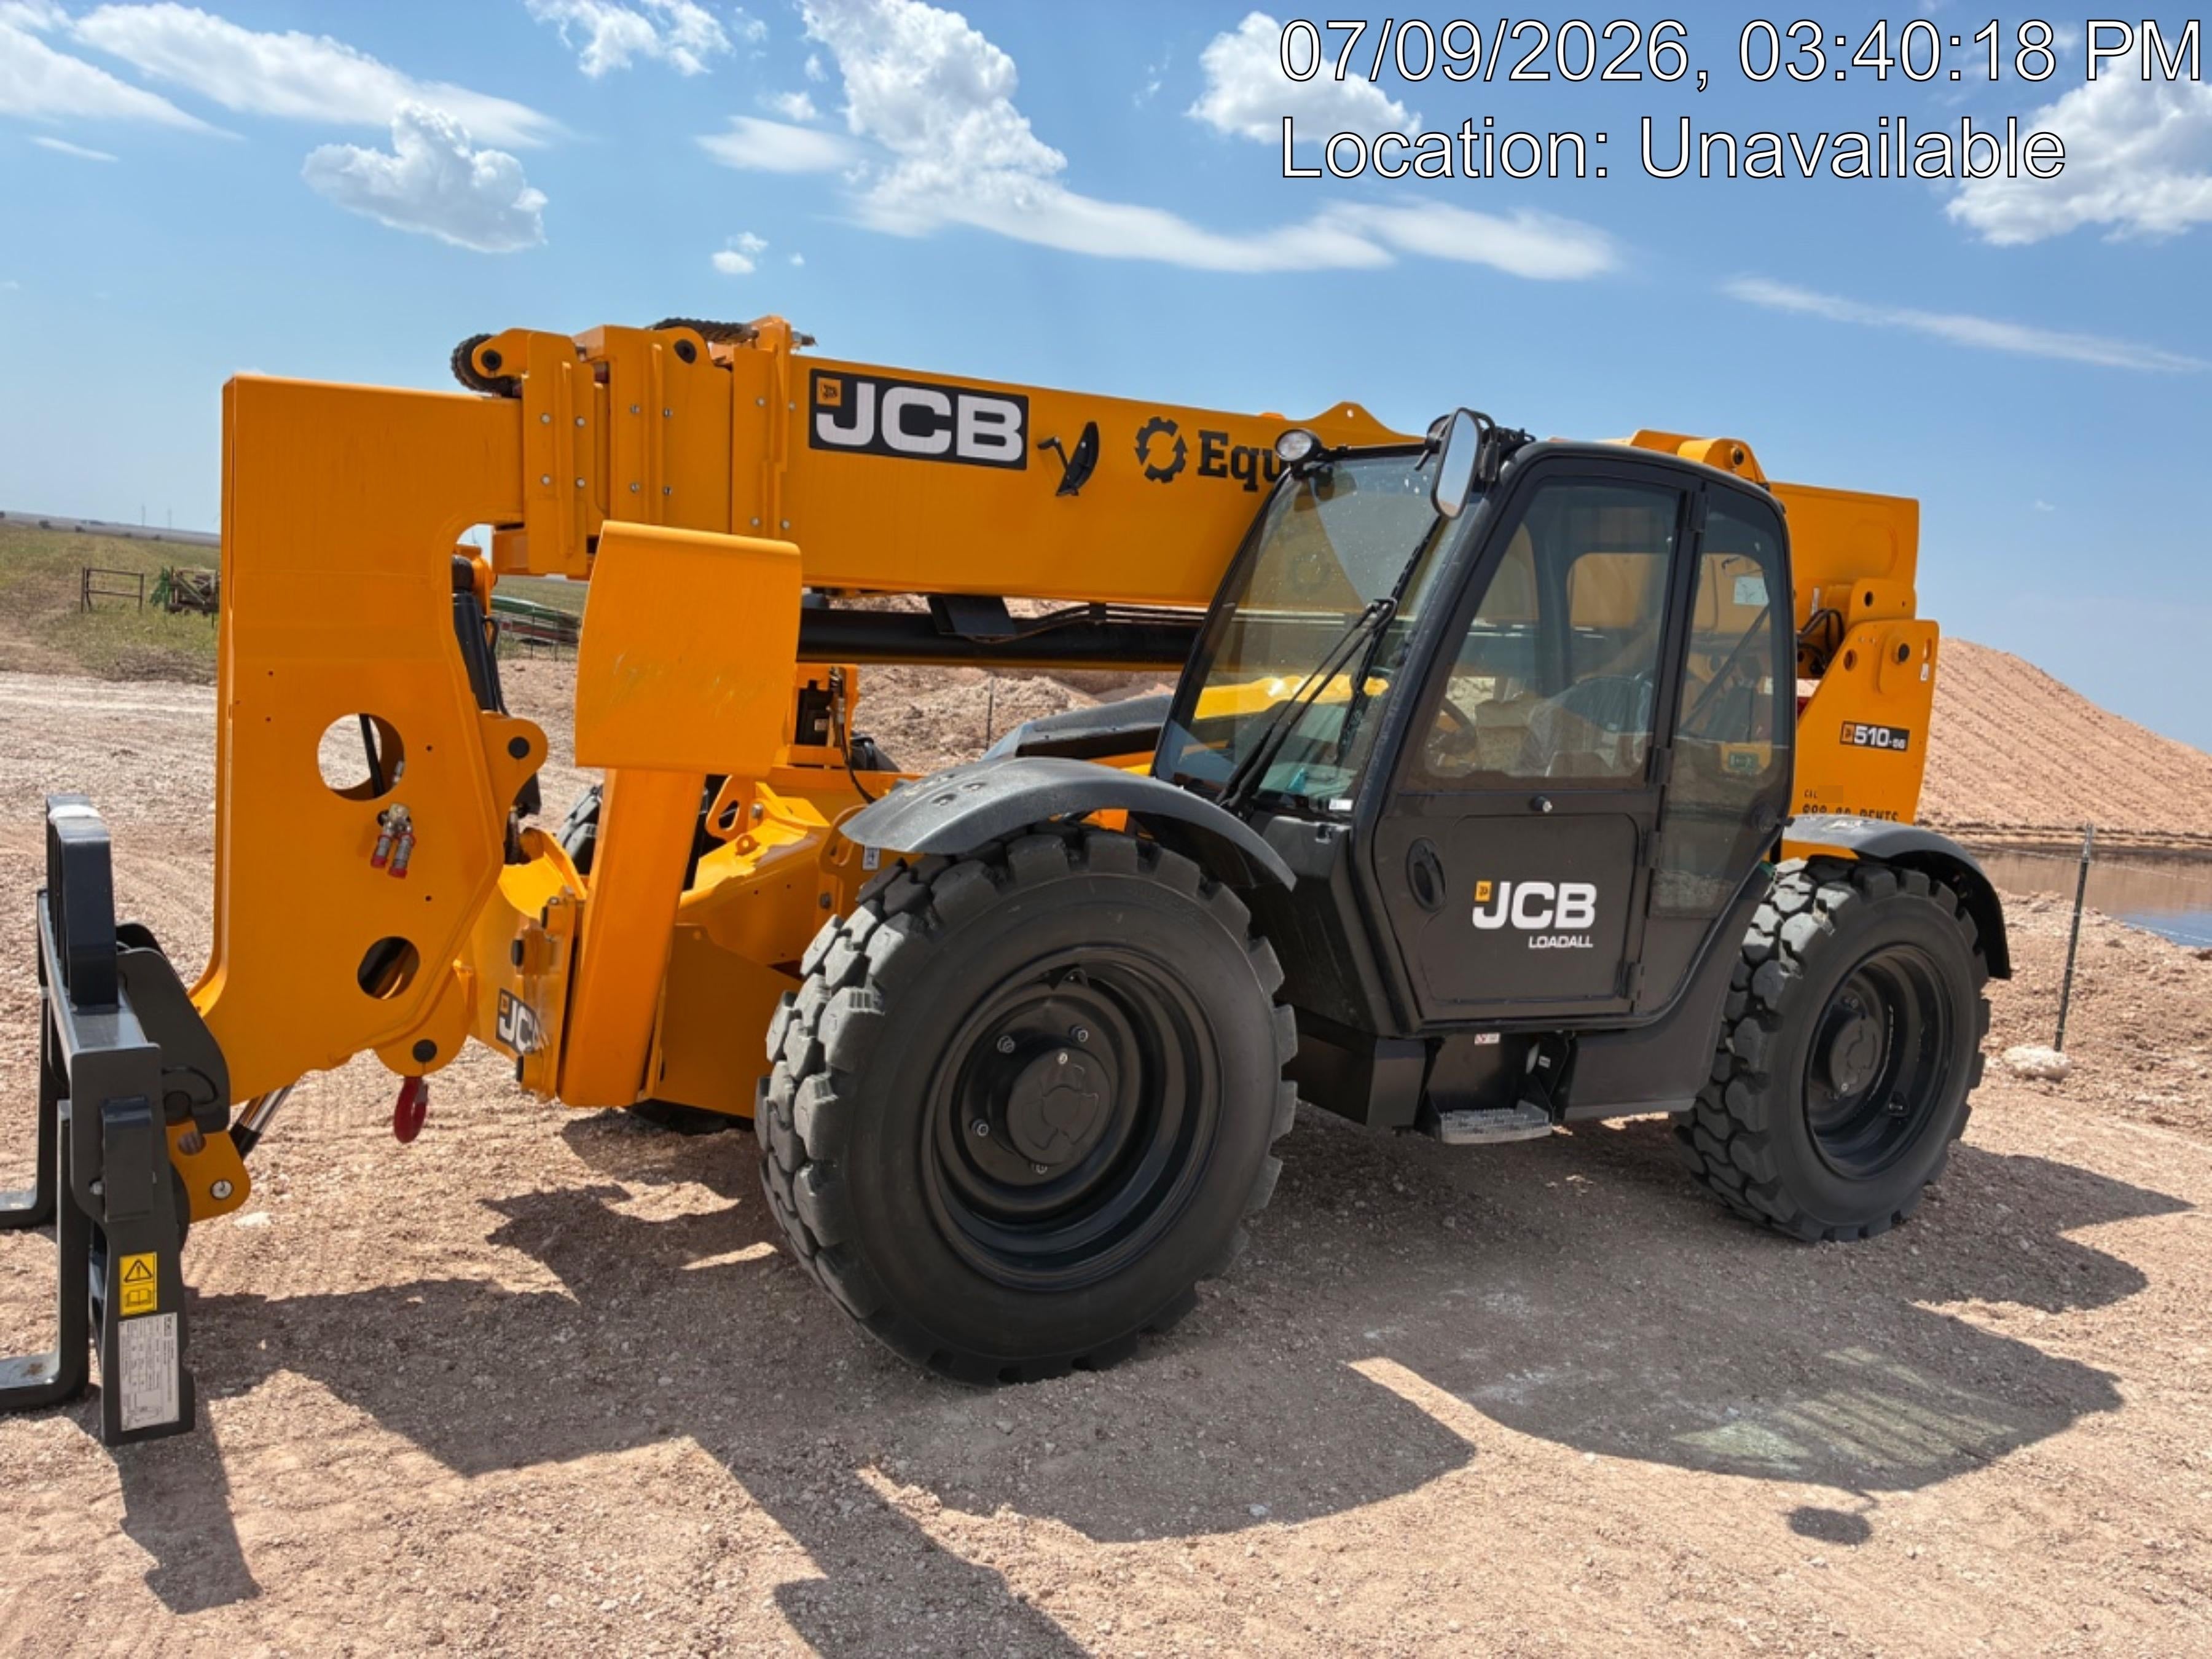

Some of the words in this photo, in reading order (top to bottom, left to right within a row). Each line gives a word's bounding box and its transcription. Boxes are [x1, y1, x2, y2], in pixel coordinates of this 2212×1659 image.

[815, 382, 1024, 463] JCB
[1472, 880, 1598, 930] JCB
[1528, 935, 1594, 949] LOADALL
